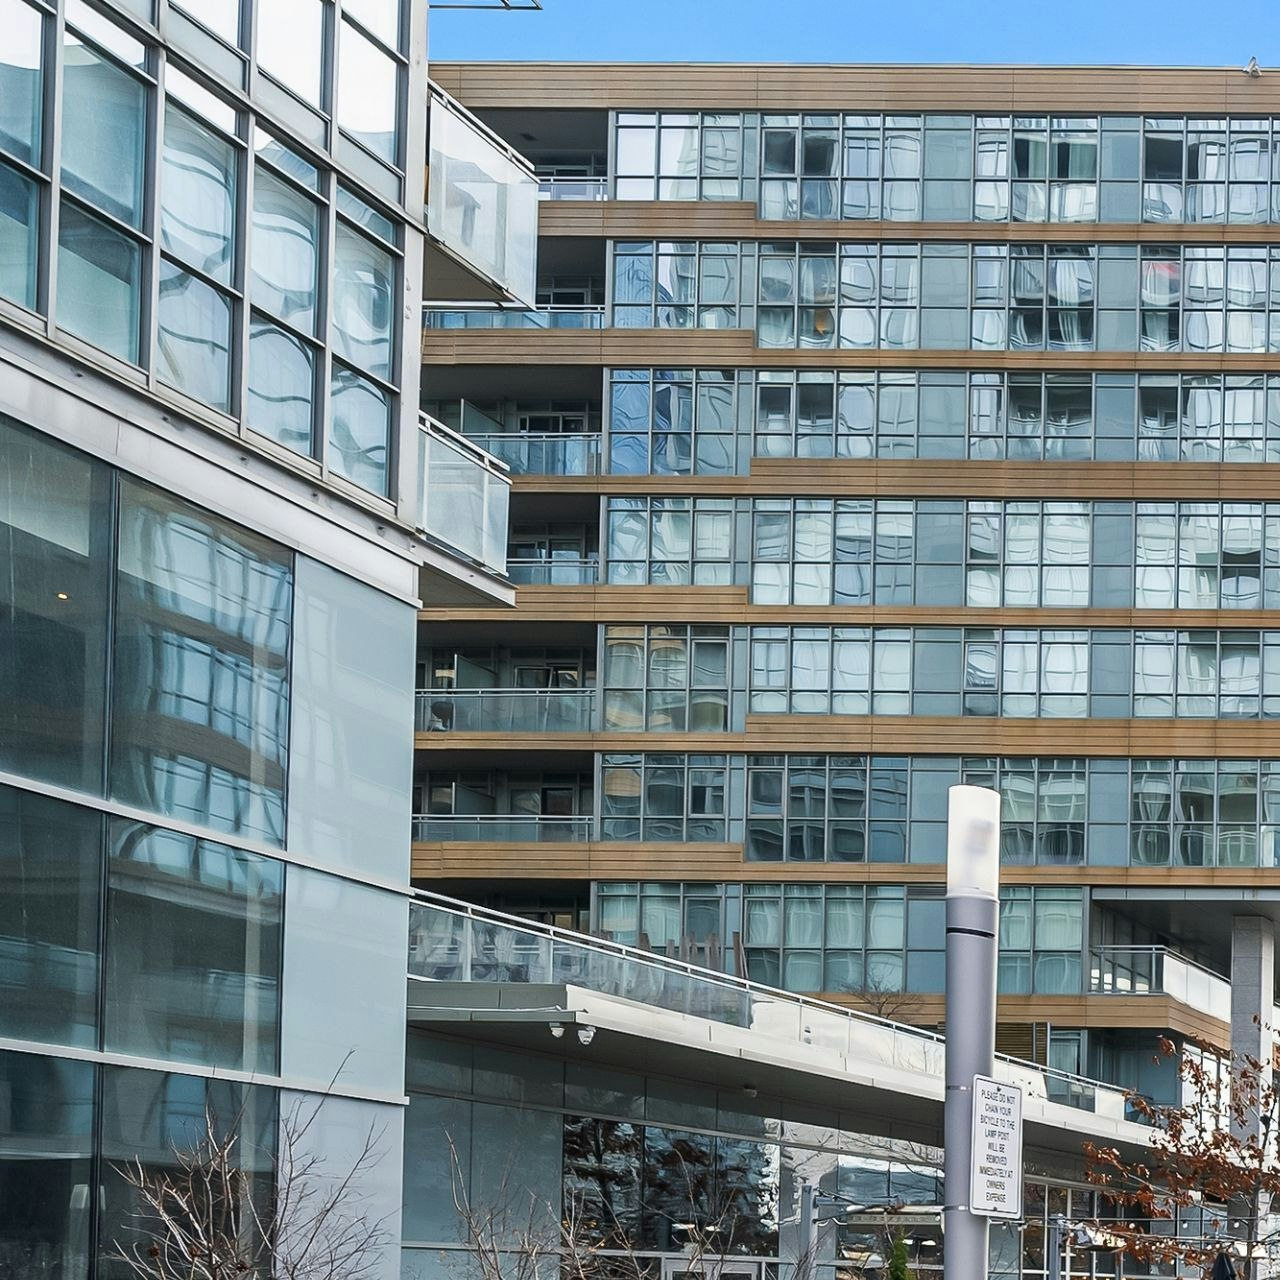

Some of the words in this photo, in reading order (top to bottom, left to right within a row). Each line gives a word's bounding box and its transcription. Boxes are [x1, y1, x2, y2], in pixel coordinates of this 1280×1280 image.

[981, 1089, 999, 1102] PLEASE
[999, 1093, 1006, 1103] DO
[1006, 1095, 1016, 1105] NOT
[985, 1103, 998, 1113] CHAIN
[999, 1106, 1012, 1116] YOUR
[980, 1114, 999, 1127] BICYCLE
[999, 1118, 1006, 1128] TO
[1006, 1119, 1015, 1130] THE
[985, 1128, 997, 1138] LAMP
[997, 1130, 1009, 1141] POST
[987, 1142, 998, 1152] WILL
[998, 1143, 1005, 1153] BE
[986, 1154, 1007, 1166] REMOVED
[978, 1166, 1007, 1178] IMMEDIATELY
[1008, 1169, 1014, 1179] AT
[986, 1179, 1005, 1191] OWNERS
[985, 1191, 1006, 1203] EXPENSE
